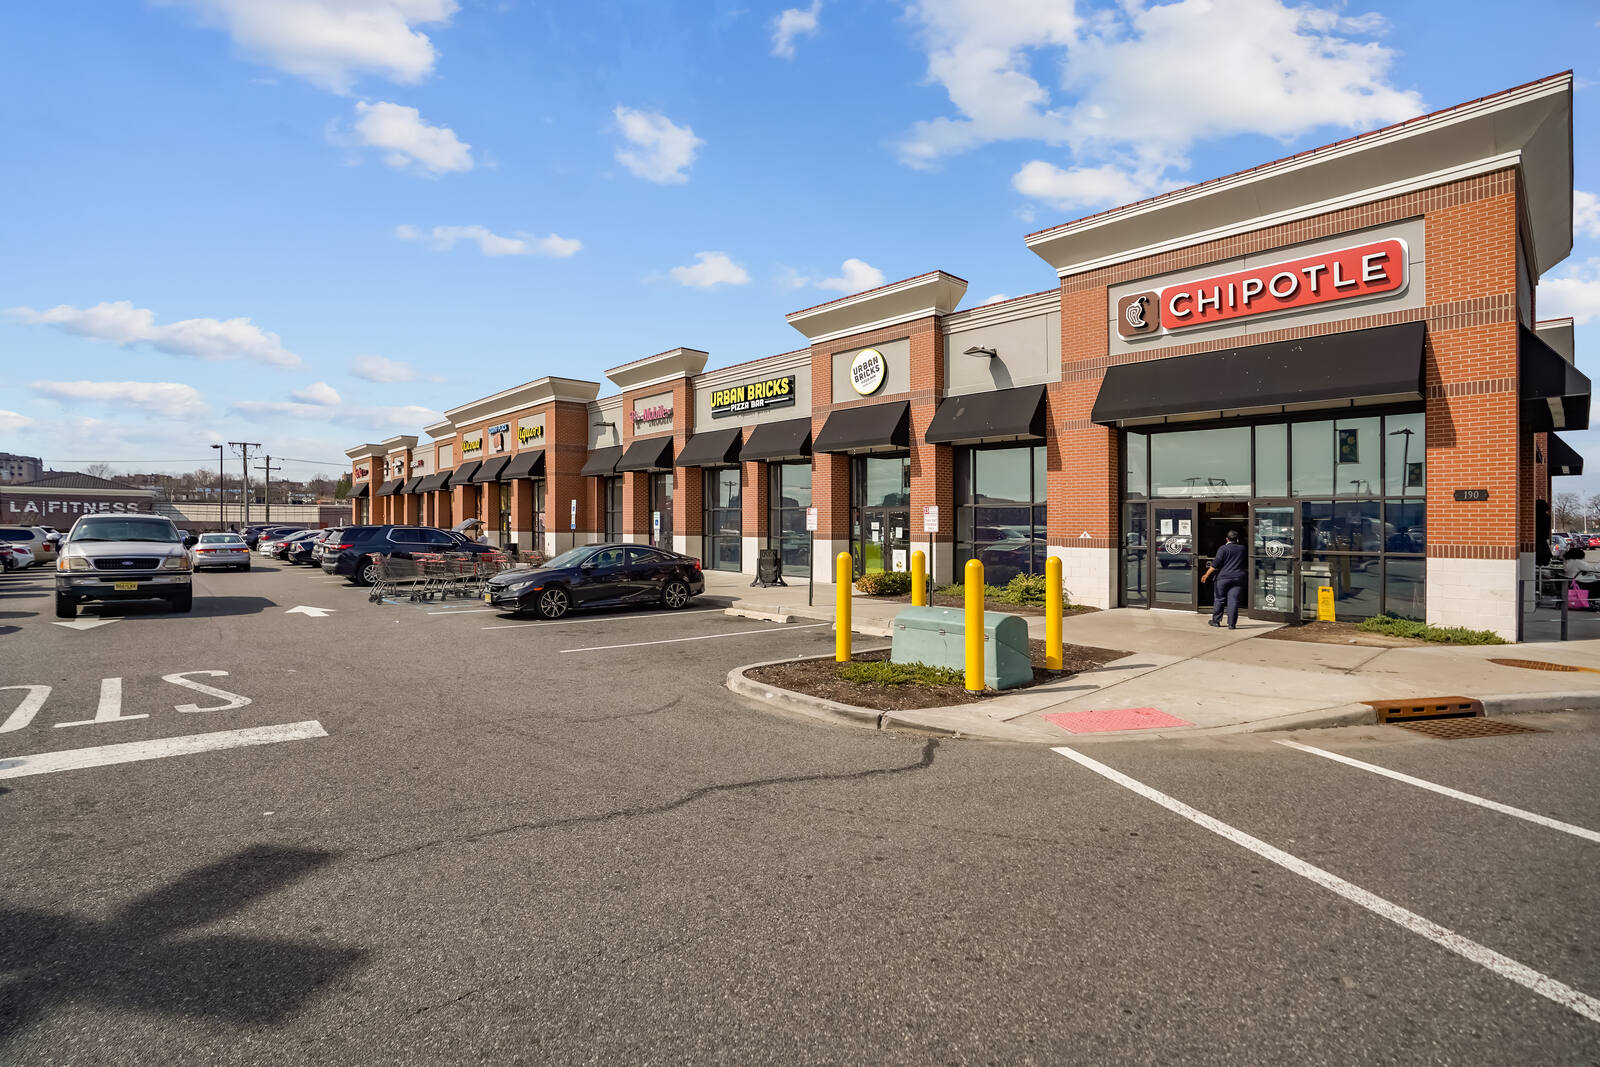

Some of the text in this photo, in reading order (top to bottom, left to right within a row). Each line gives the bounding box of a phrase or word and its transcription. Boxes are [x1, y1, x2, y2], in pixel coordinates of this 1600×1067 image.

[1169, 251, 1387, 317] CHIPOTLE
[853, 356, 879, 375] URBAN
[854, 364, 880, 383] BRICKS
[710, 377, 790, 407] URBAN BRICKS
[730, 399, 764, 412] PIZZA BAR
[1464, 491, 1479, 499] 190
[9, 500, 139, 514] LA FITNESS
